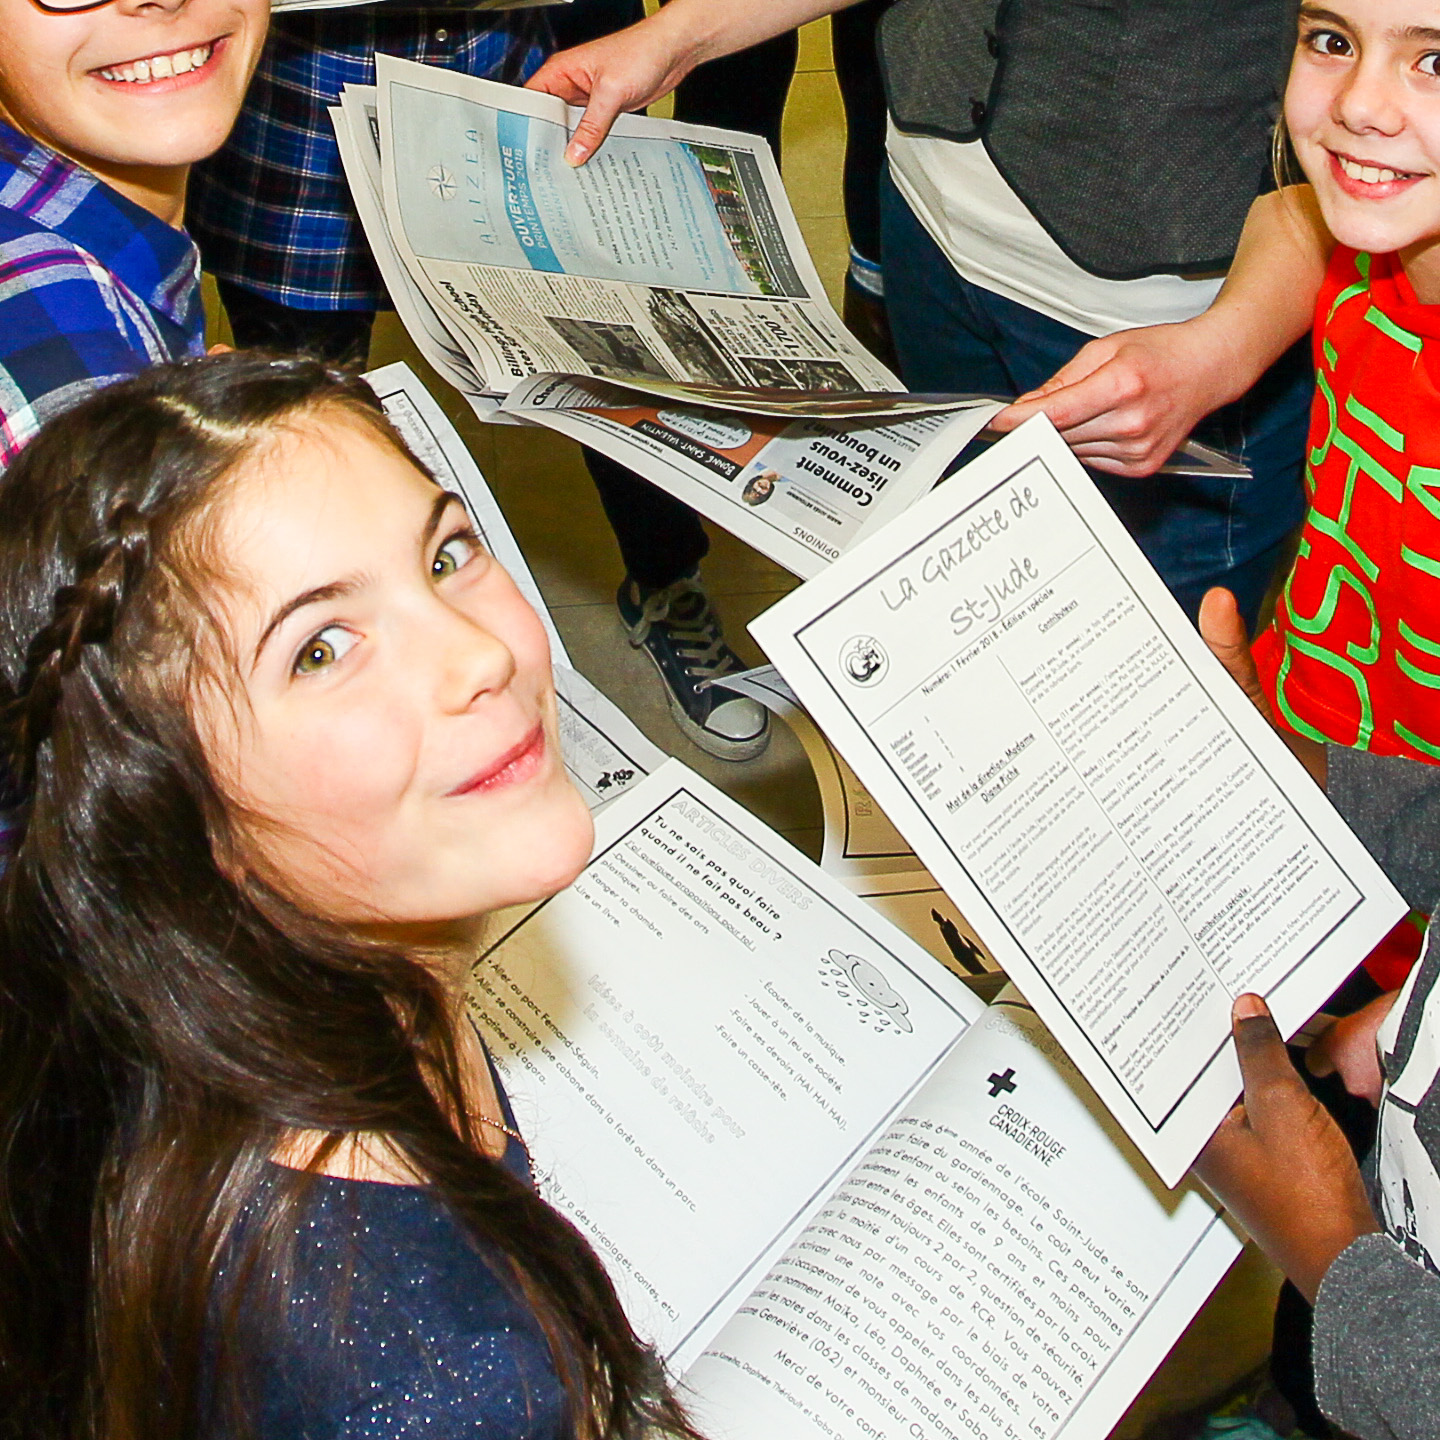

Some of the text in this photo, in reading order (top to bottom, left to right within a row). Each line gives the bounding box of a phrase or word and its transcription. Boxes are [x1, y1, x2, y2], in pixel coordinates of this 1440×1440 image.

[502, 146, 535, 247] OUVERTURE
[518, 182, 548, 249] PRINTEMPS
[492, 334, 524, 377] Billings
[796, 456, 874, 507] Comment
[810, 440, 888, 492] lisez-vous
[877, 453, 902, 473] un
[792, 526, 840, 560] OPINIONS
[880, 486, 1039, 611] La Gazette de
[951, 557, 1039, 636] St-Jude
[979, 630, 999, 649] 2018
[980, 784, 1001, 804] Diane
[641, 827, 771, 934] quand il ne fait pas beau
[654, 815, 781, 921] Tu ne sais pas quoi faire
[671, 799, 815, 911] ARTICLES DIVERS
[749, 998, 842, 1095] Jouer à un jeu de société.
[763, 981, 846, 1067] Écouter de la musique.
[988, 1114, 1056, 1168] CANADIENNE
[997, 1104, 1068, 1160] CROIX-ROUGE
[950, 1158, 1102, 1288] gardiennage. Le coût peut
[960, 1138, 1150, 1304] année de l'école Saint-Jude se sont
[590, 1223, 680, 1322] bricolages, contes, etc.)
[758, 1307, 908, 1425] Geneviève (062) et monsieur
[822, 1290, 942, 1398] Maïka, Léa, Daphnée
[970, 1300, 1074, 1406] RCR. Vous pouvez
[980, 1282, 1084, 1389] question de sécurité.
[773, 1349, 855, 1418] Merci de votre
